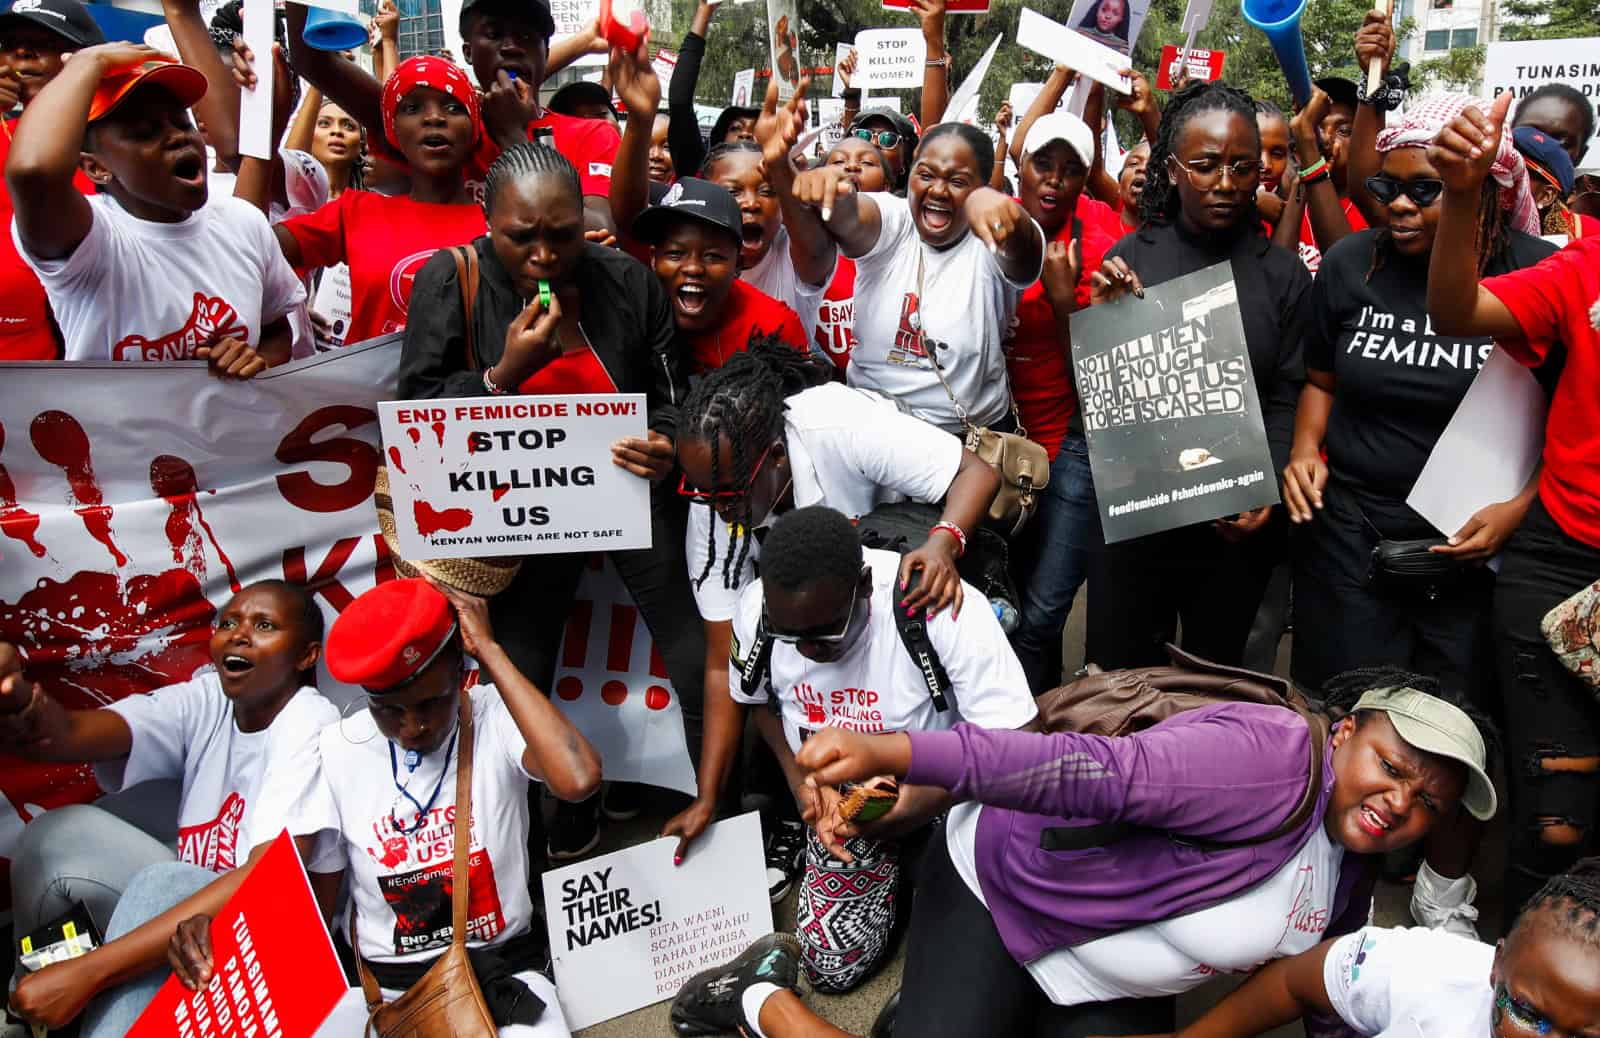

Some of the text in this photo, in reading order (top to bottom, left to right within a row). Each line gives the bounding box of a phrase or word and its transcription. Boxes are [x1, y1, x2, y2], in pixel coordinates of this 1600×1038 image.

[877, 40, 908, 49] STOP
[868, 56, 916, 65] KILLING
[869, 71, 914, 79] WOMEN
[1358, 306, 1394, 329] I'm
[1401, 318, 1416, 332] a
[1077, 316, 1213, 376] NOT ALL MEN
[1079, 343, 1204, 395] BUT ENOUGH
[1083, 358, 1247, 413] FOR ALL OF US
[397, 402, 637, 424] END FEMICIDE NOW!
[1087, 387, 1243, 431] TO BE SCARED
[473, 428, 567, 452] STOP
[449, 466, 595, 492] KILLING
[502, 506, 550, 527] US
[1108, 492, 1170, 517] #endfemicide
[431, 529, 623, 546] KENYAN WOMEN ARE NOT SAFE
[742, 640, 764, 683] MILLET
[918, 652, 941, 699] MILLET
[831, 688, 879, 707] STOP
[832, 706, 882, 721] KILLING
[562, 867, 612, 902] SAY
[562, 888, 633, 925] THEIR
[566, 900, 662, 951] NAMES!
[649, 905, 725, 938] RITA WAENI
[651, 911, 750, 952] SCARLET WAHU
[401, 932, 429, 947] END
[653, 928, 746, 966] RAHAB KARISA
[655, 959, 694, 980] DIANA
[208, 972, 234, 1036] DHIDI
